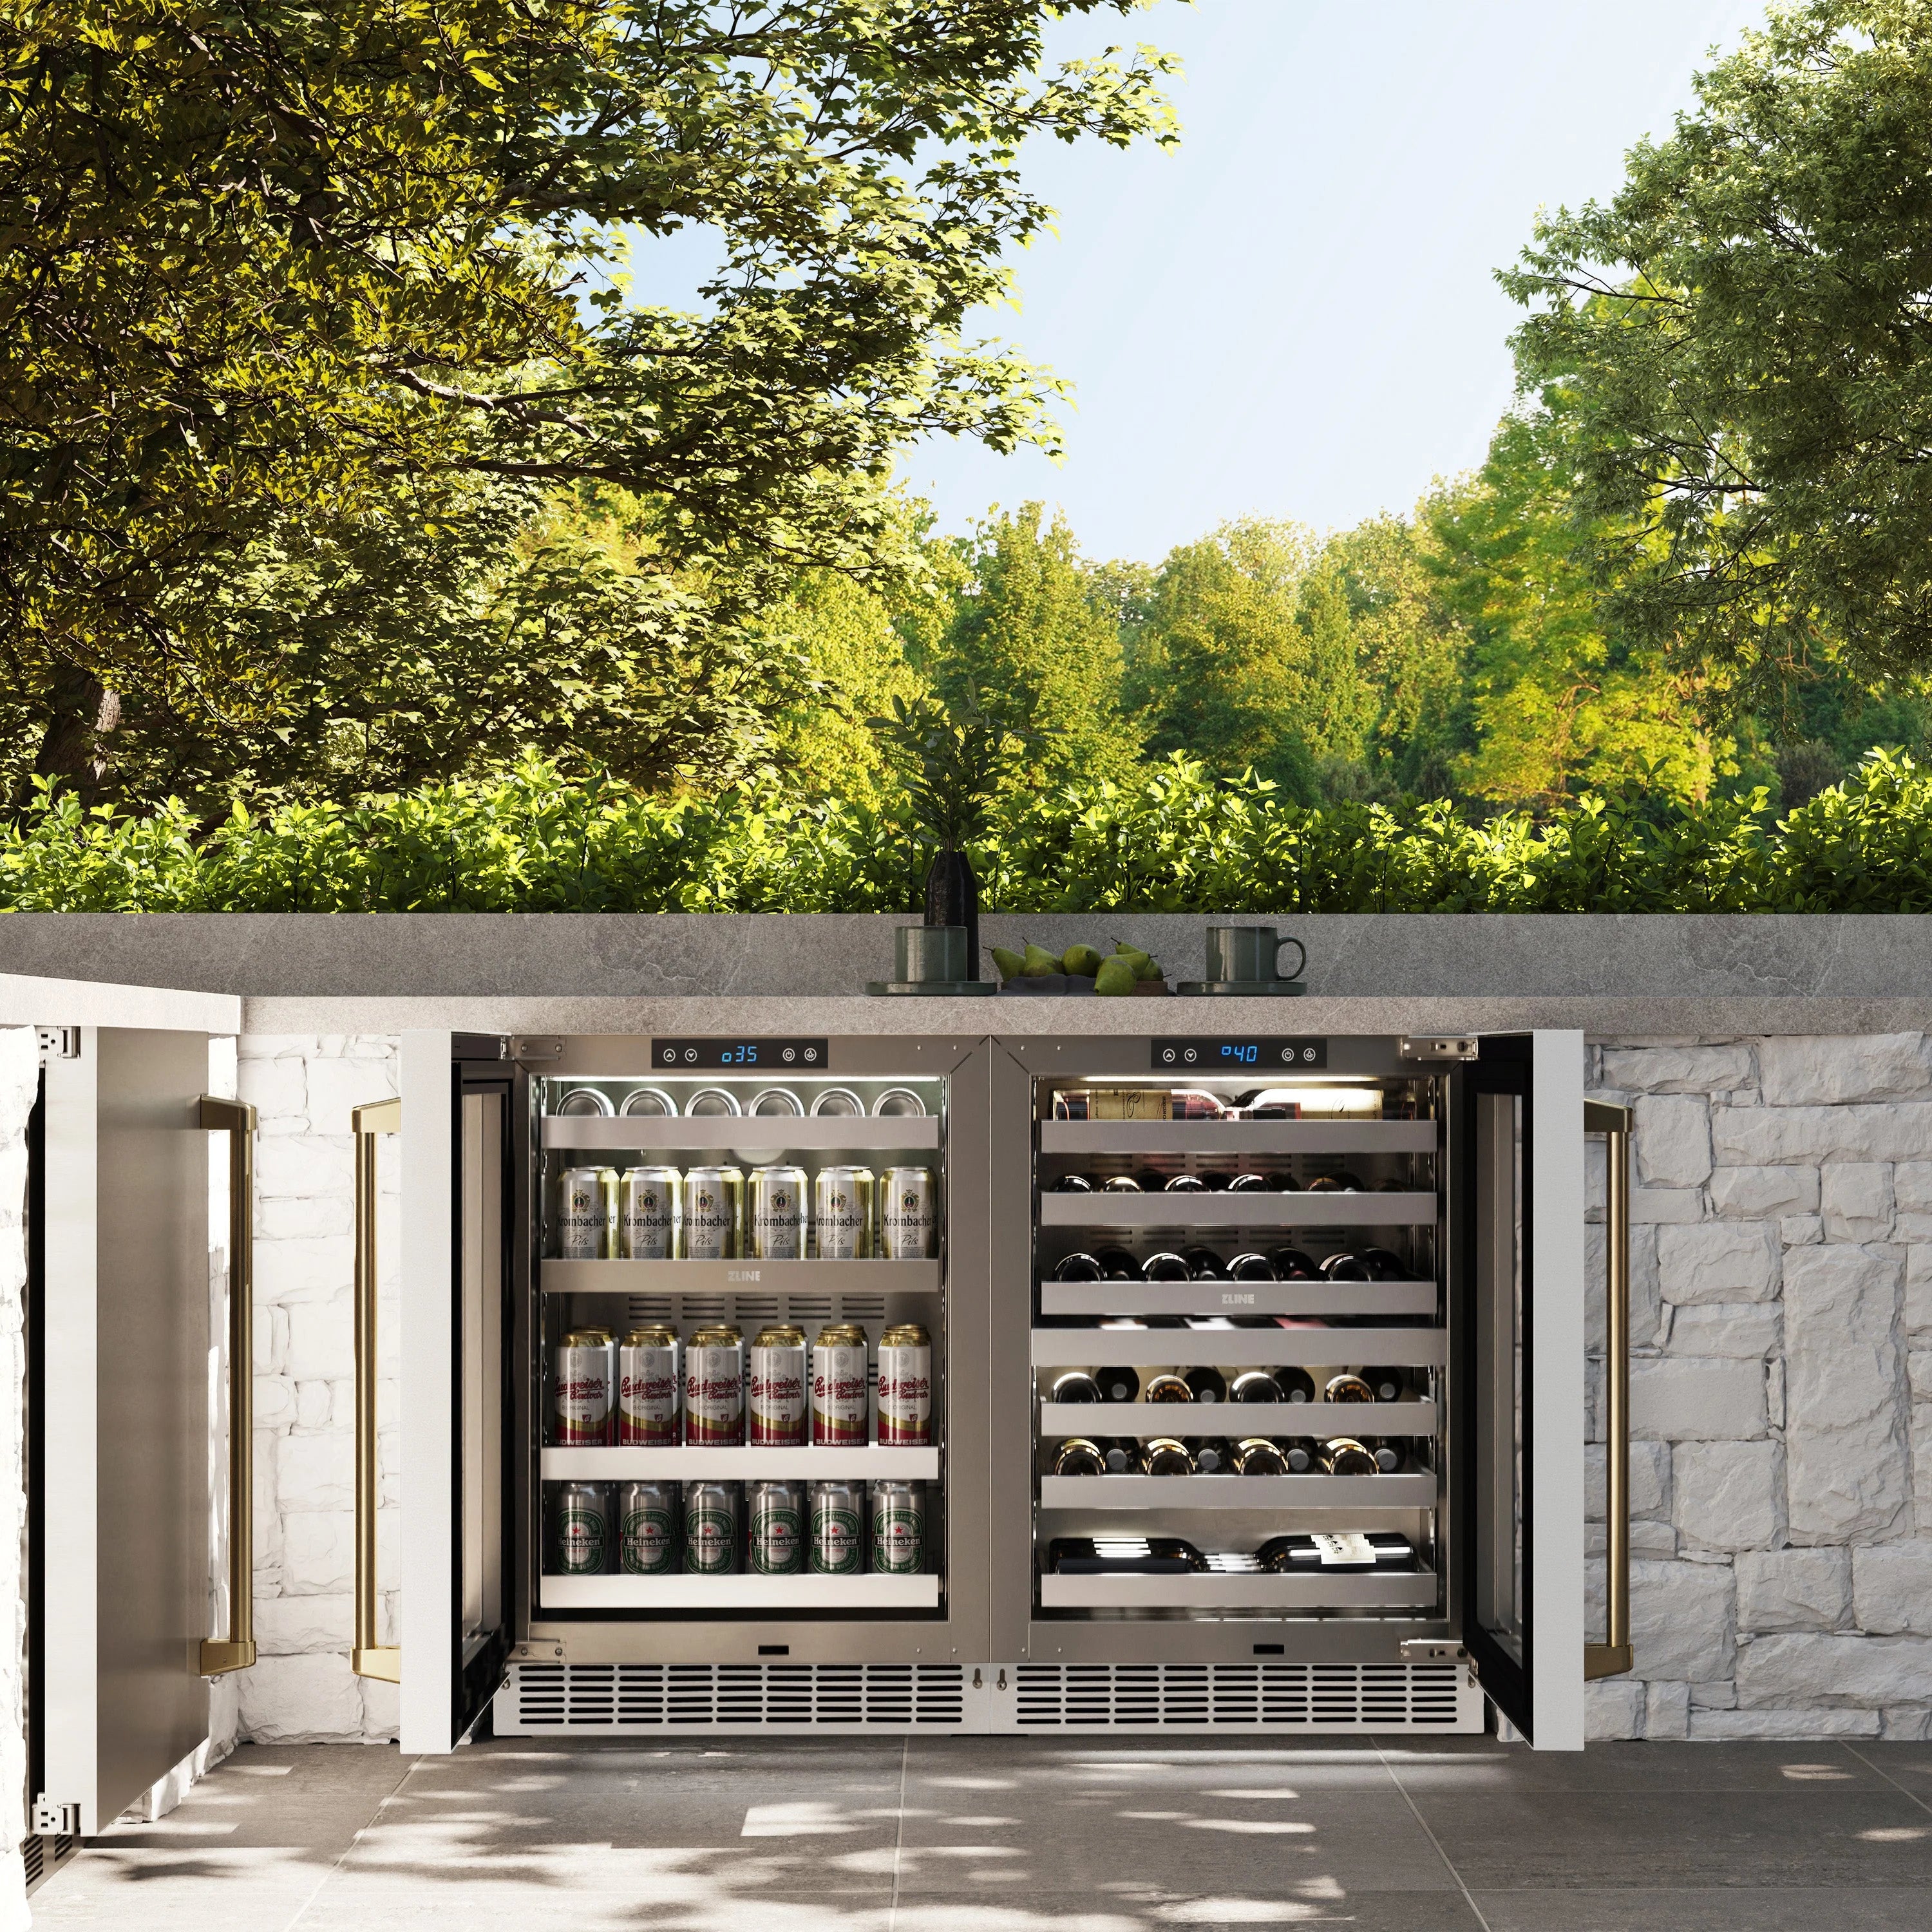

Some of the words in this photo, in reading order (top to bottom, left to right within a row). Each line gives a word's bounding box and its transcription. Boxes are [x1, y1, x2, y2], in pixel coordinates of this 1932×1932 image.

[623, 1215, 672, 1226] Krombacher
[884, 1215, 932, 1226] Krombacher
[567, 1235, 589, 1246] Pils
[636, 1235, 658, 1246] Pils
[694, 1235, 712, 1246] Pils
[770, 1235, 790, 1246] Pils
[896, 1235, 918, 1246] Pils
[728, 1271, 760, 1281] ZLINE
[1222, 1294, 1254, 1303] ZLINE
[621, 1376, 672, 1394] Budweiser
[687, 1376, 738, 1394] Budweiser
[815, 1376, 866, 1394] Budweiser
[558, 1537, 600, 1546] Heineken
[627, 1537, 670, 1546] Heineken
[688, 1537, 731, 1546] Heineken
[756, 1537, 799, 1546] Heineken
[813, 1537, 857, 1546] Heineken
[877, 1537, 920, 1546] Heineken
